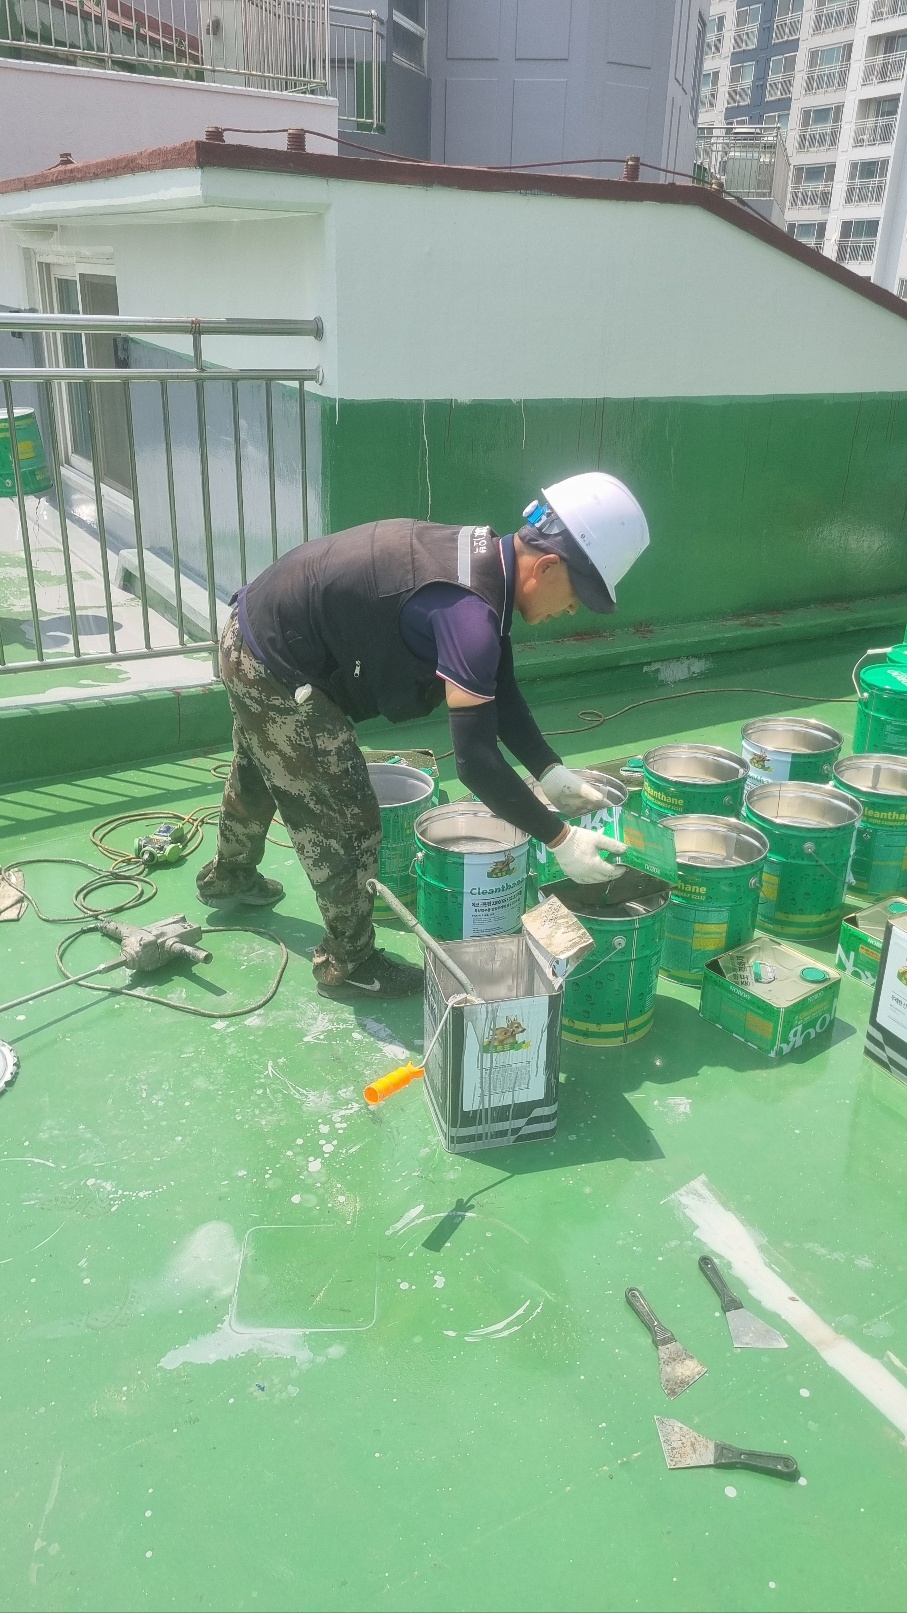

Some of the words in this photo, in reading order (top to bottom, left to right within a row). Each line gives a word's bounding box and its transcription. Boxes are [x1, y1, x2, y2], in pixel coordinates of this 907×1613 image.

[863, 807, 907, 820] leantha
[677, 880, 707, 894] hane
[868, 938, 882, 948] NOR
